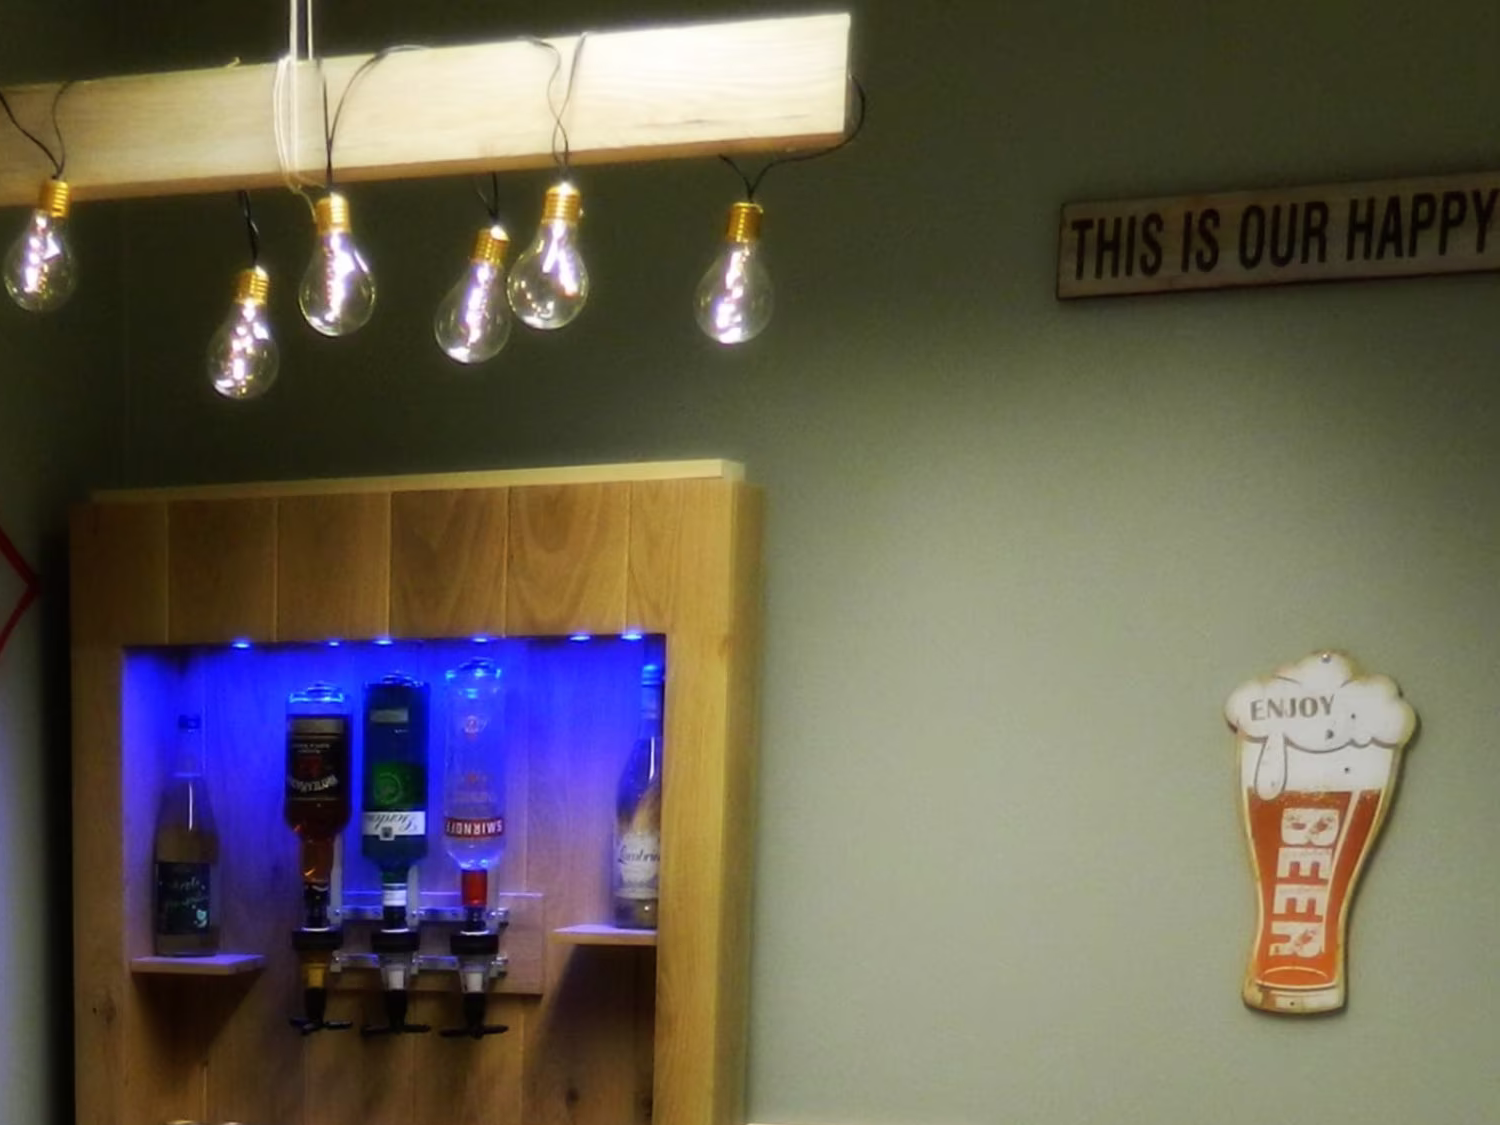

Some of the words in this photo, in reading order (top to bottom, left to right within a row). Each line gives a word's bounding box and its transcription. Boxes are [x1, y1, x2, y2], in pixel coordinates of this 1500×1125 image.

[1071, 212, 1164, 281] THIS
[1180, 208, 1221, 273] IS
[1237, 200, 1329, 270] OUR
[1345, 187, 1500, 262] HAPPY
[1249, 694, 1336, 722] ENJOY
[1269, 807, 1341, 958] BEER
